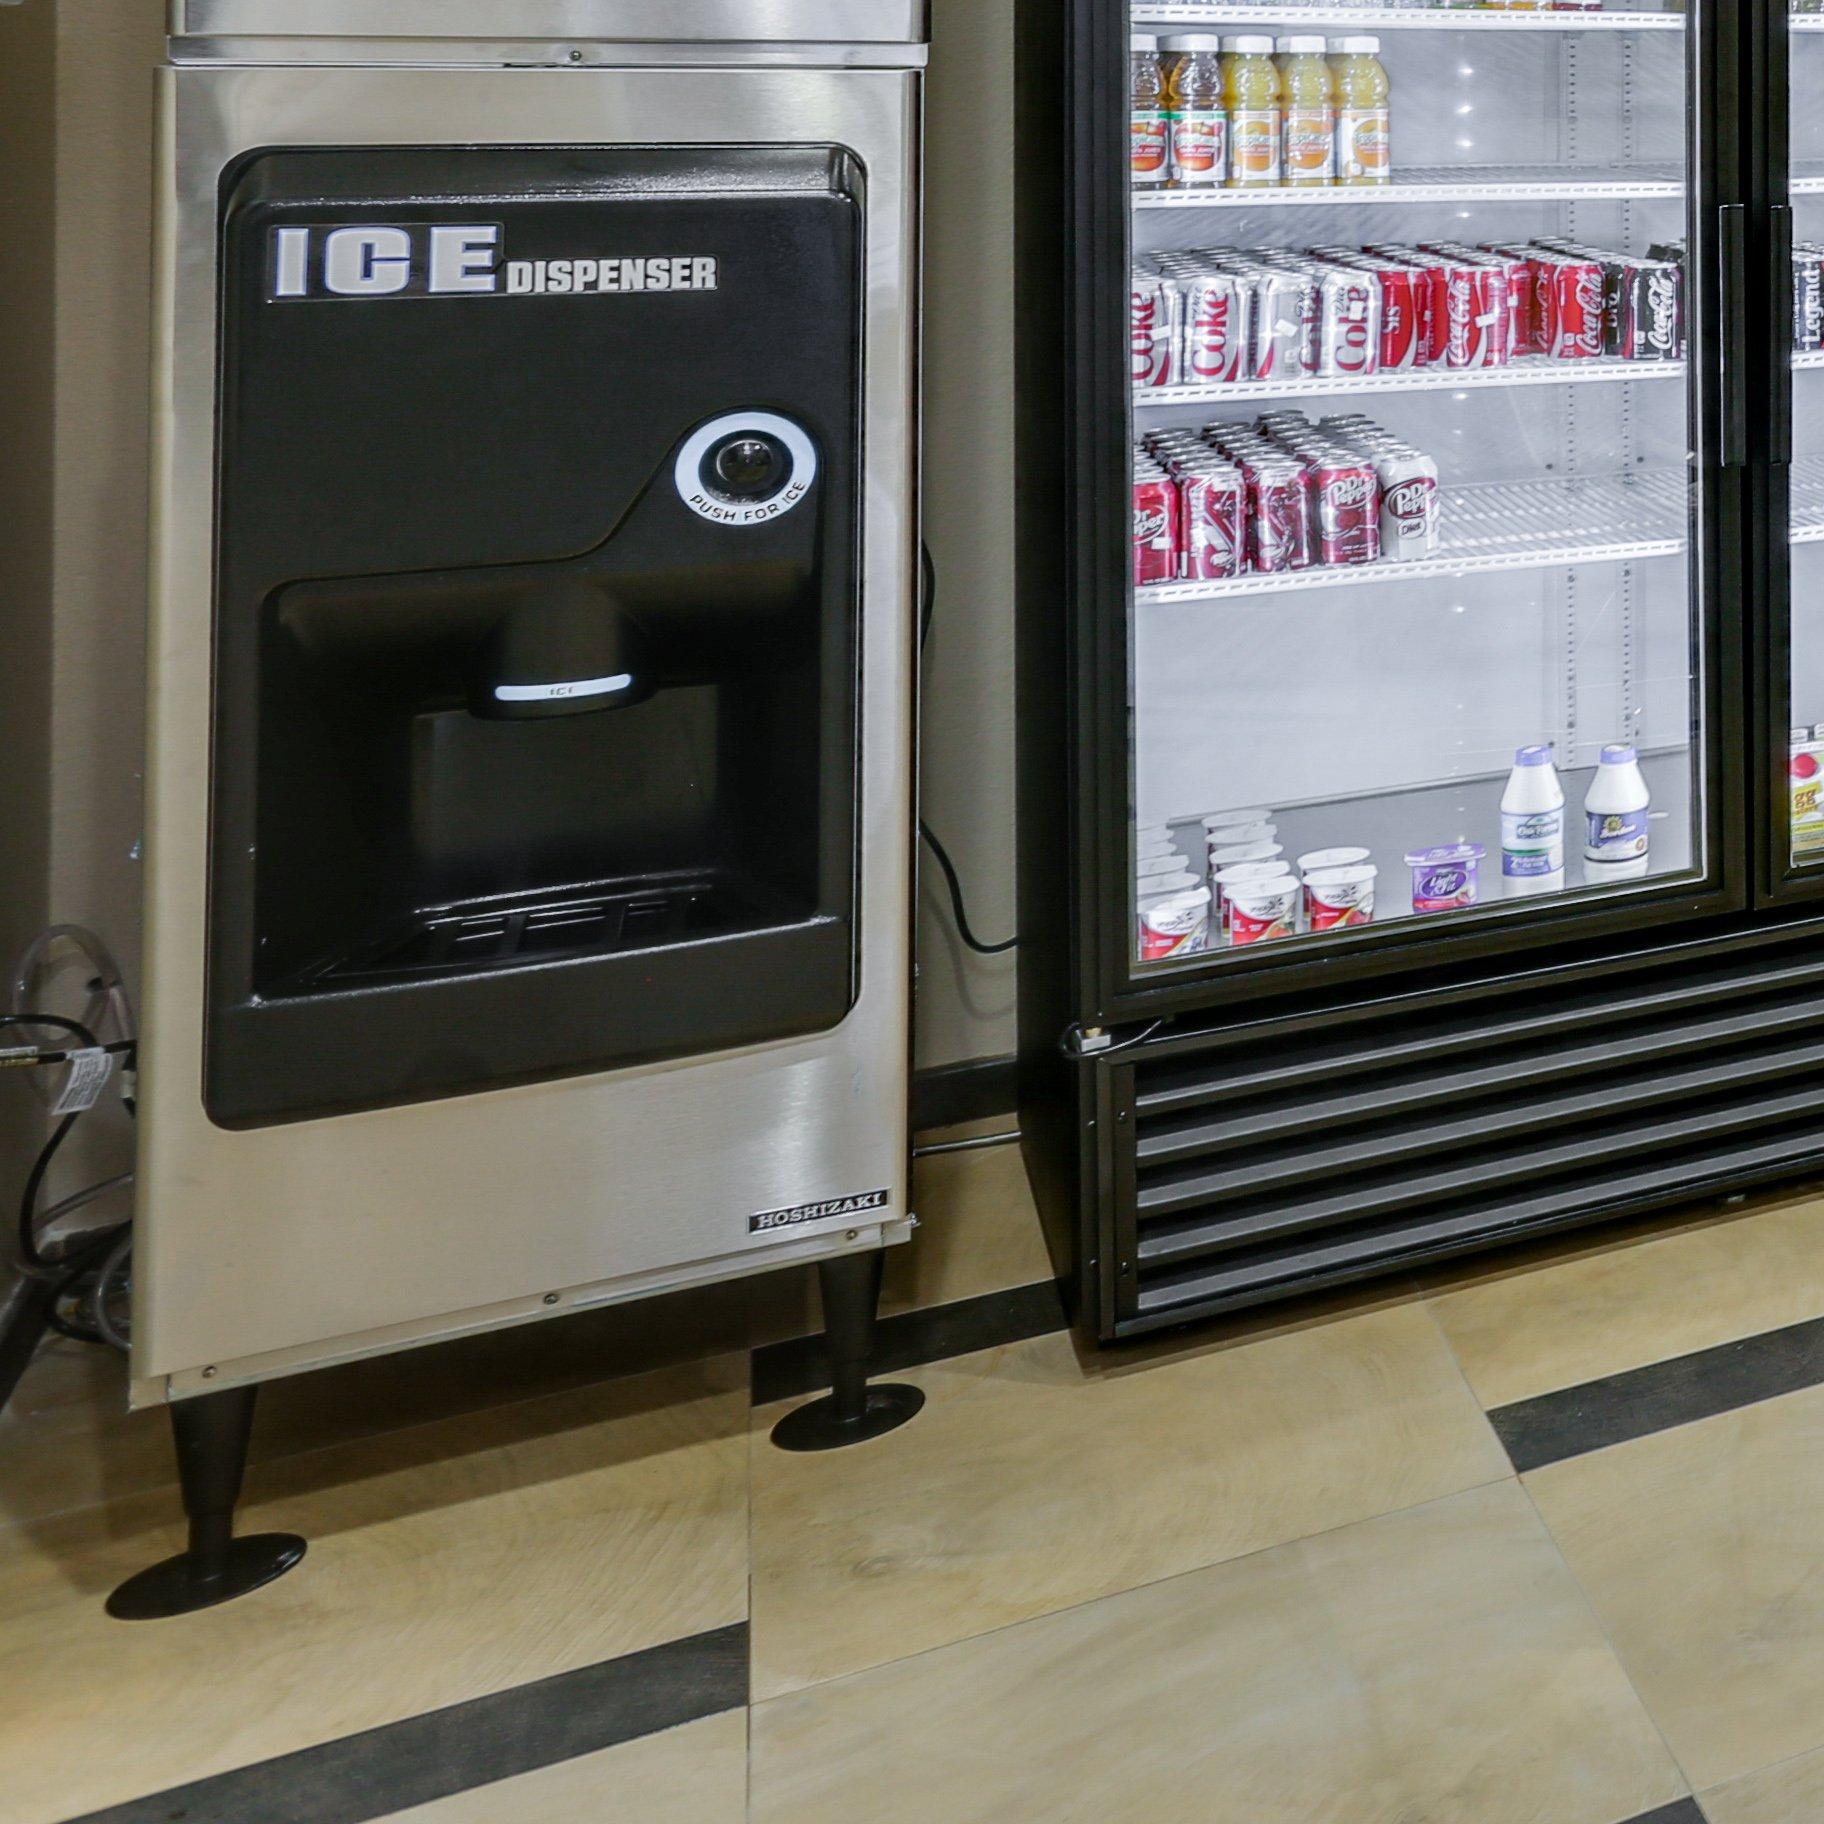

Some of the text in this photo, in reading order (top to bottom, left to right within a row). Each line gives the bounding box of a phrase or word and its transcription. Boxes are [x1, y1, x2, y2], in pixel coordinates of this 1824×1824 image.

[274, 225, 717, 299] ICE DISPENSER
[1192, 288, 1230, 376] Coke
[689, 481, 806, 521] PUSH FOR ICE
[758, 1192, 882, 1228] HOSHIZAKI
